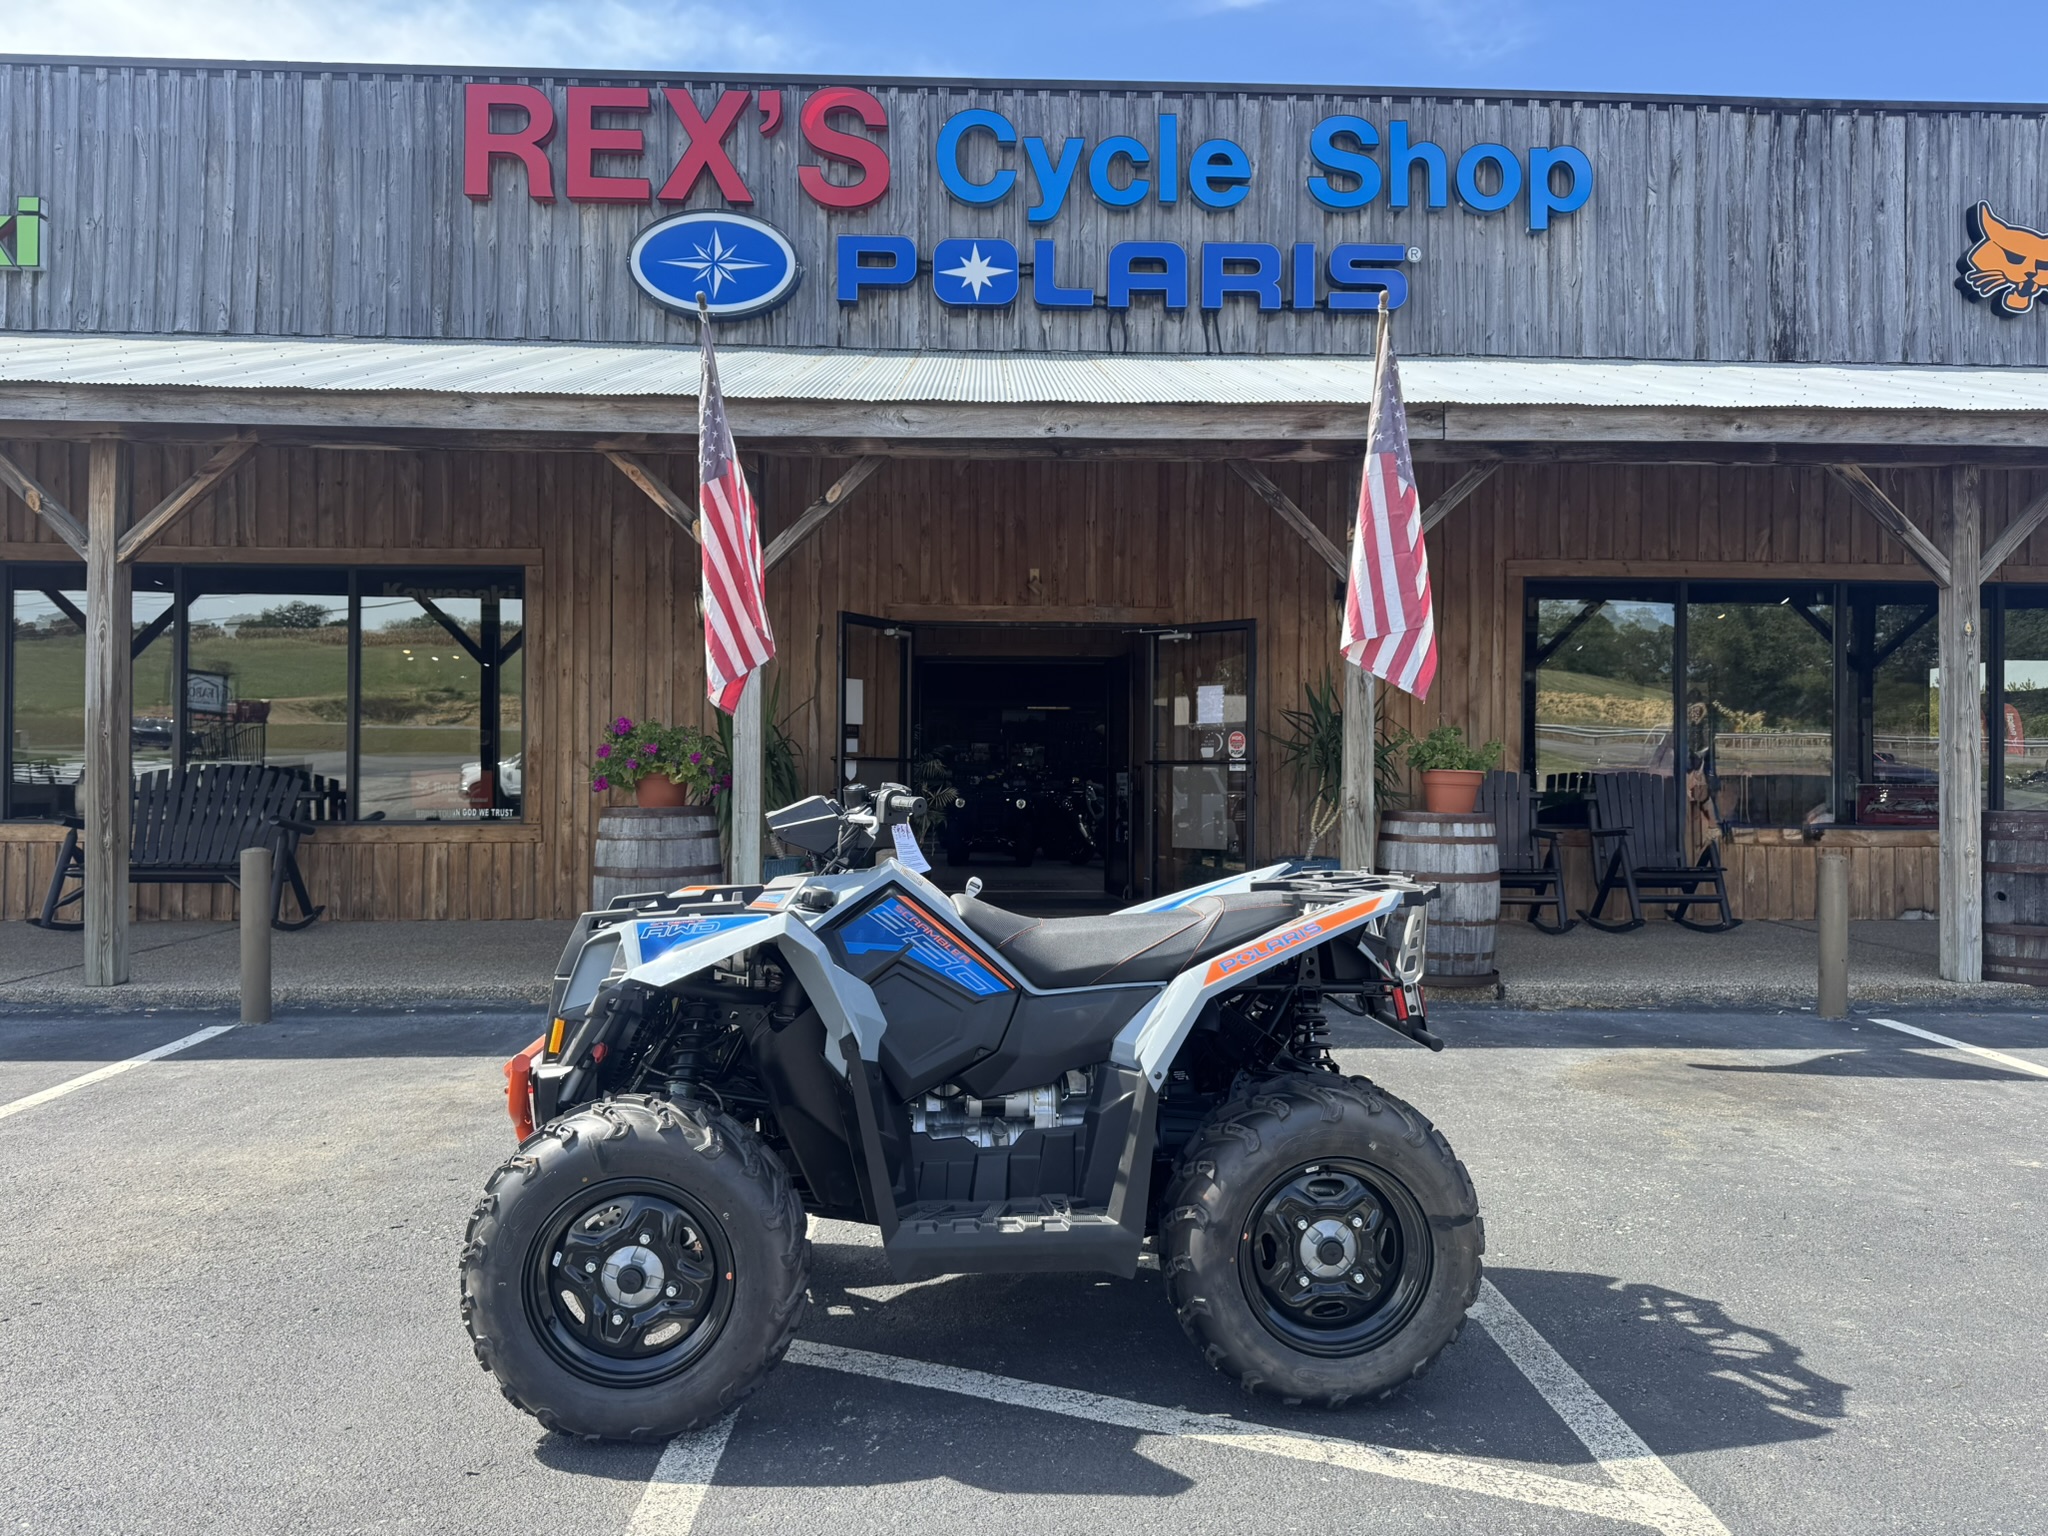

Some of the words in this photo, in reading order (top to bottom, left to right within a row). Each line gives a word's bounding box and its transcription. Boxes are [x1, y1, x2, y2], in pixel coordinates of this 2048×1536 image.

[464, 83, 891, 209] REX'S
[936, 108, 1252, 226] Cycle
[1307, 113, 1593, 233] Shop
[837, 235, 1408, 310] POLARIS
[462, 808, 477, 817] GOD
[478, 808, 489, 817] WE
[490, 808, 514, 817] TRUST
[640, 920, 720, 940] AWD
[894, 904, 971, 965] SCRAMBLER
[1218, 921, 1323, 973] POLARIS
